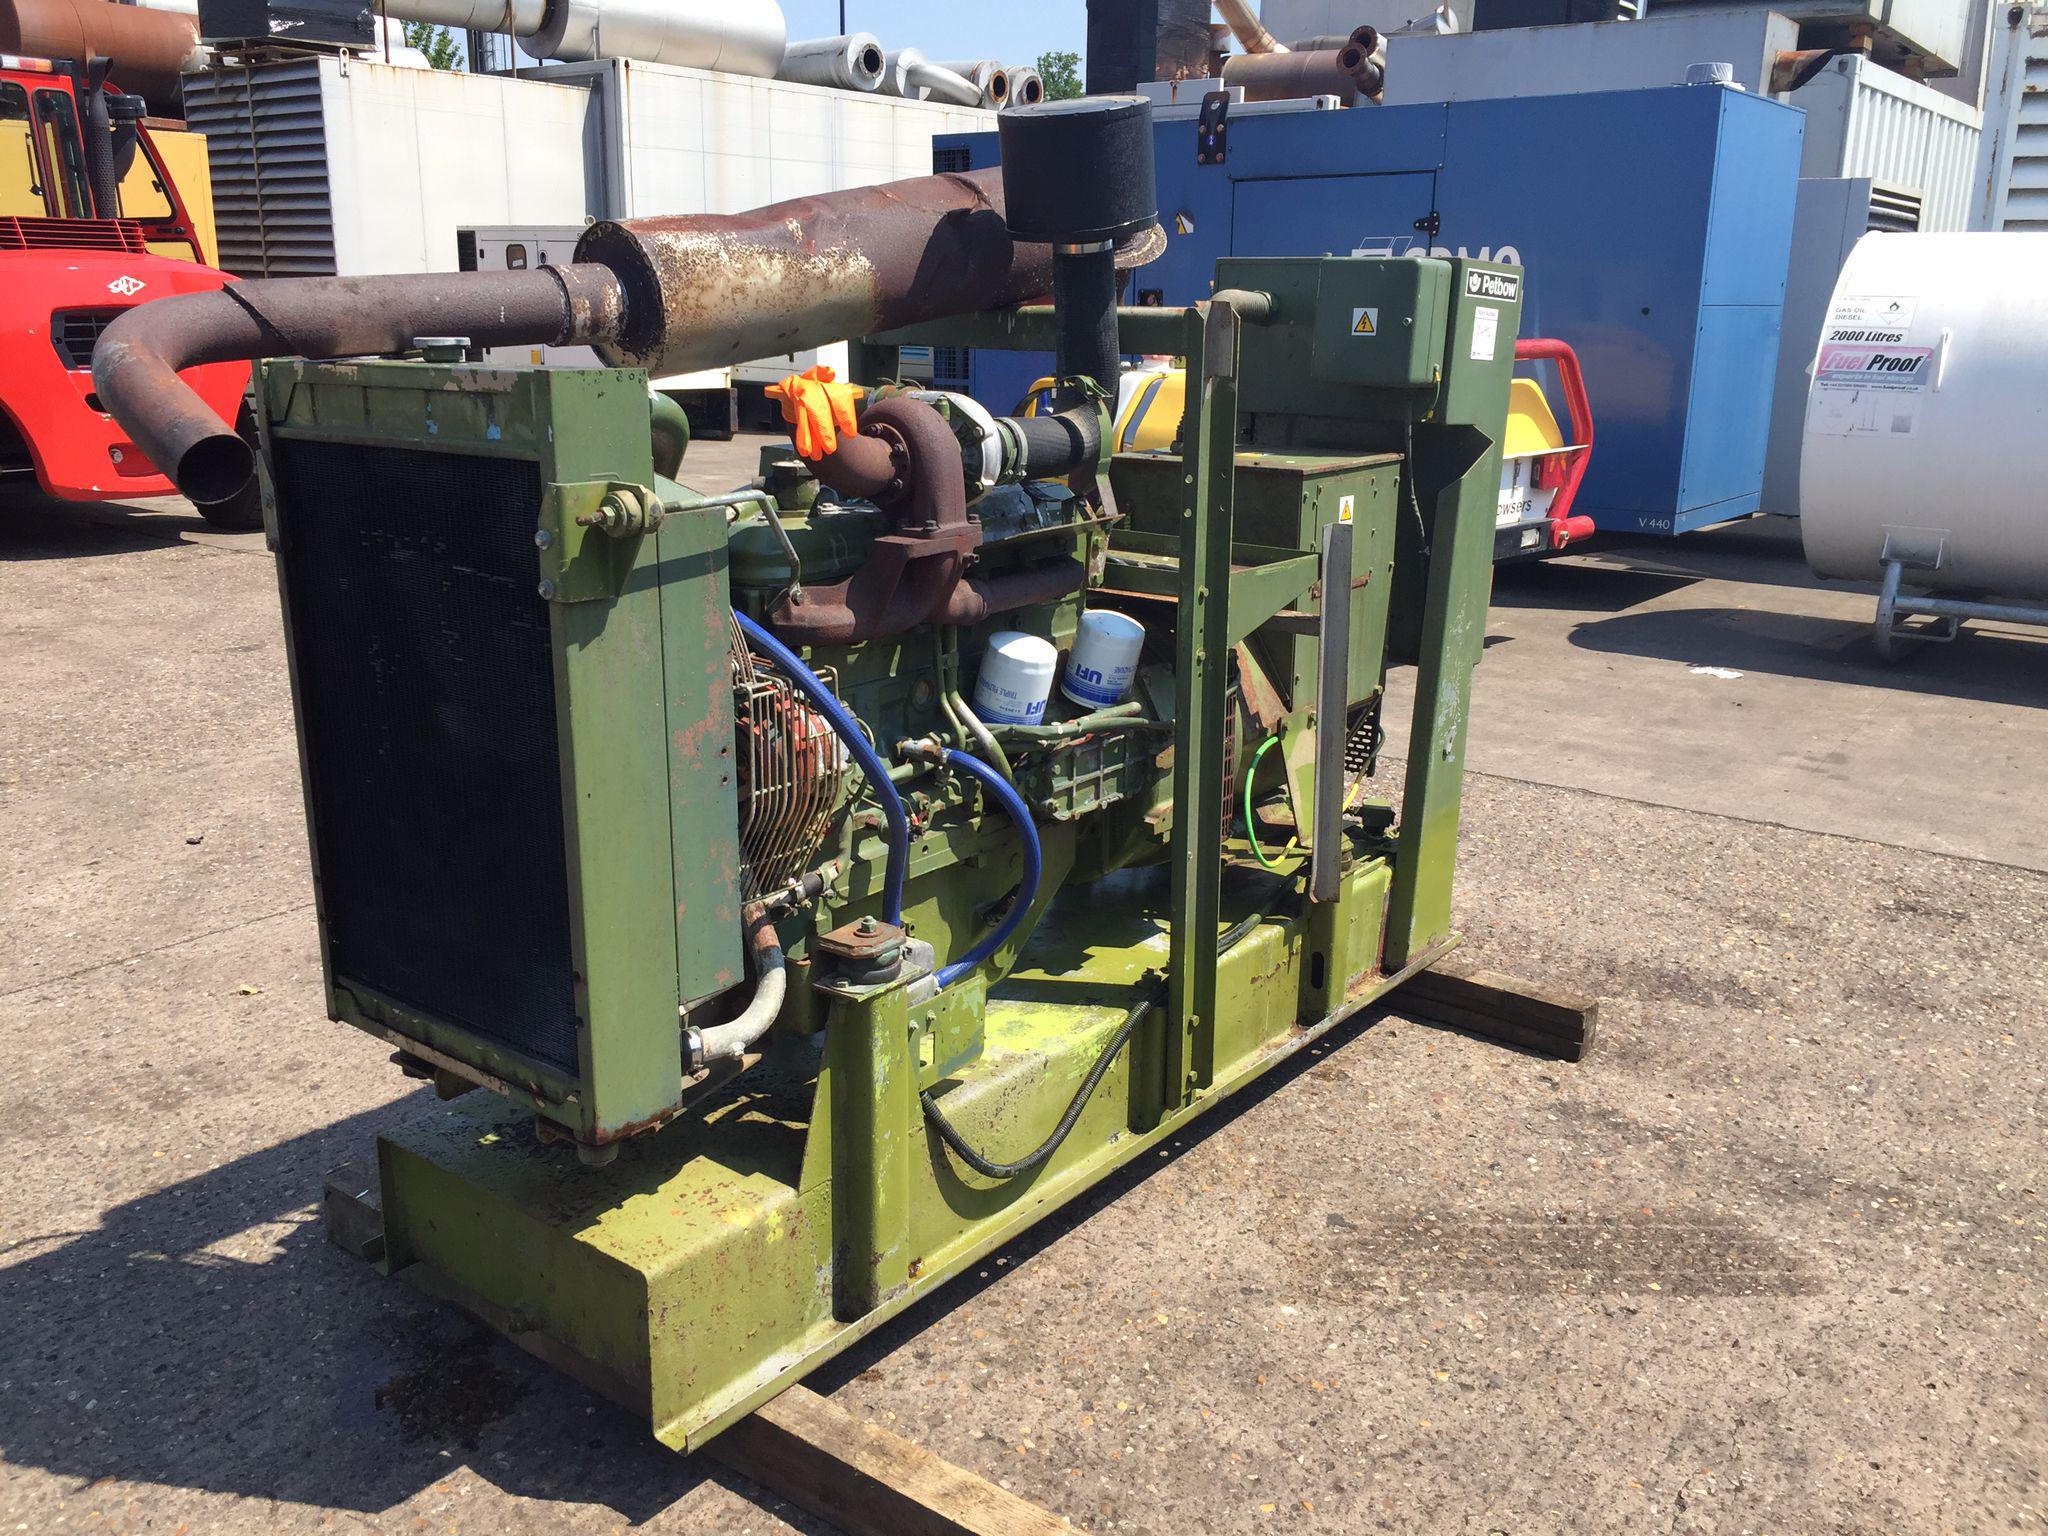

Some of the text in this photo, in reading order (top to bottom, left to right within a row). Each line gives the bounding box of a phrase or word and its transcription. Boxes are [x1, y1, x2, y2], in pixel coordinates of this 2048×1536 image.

[1482, 276, 1517, 298] Petbow
[1830, 331, 1903, 342] 2000 Litres
[1825, 352, 1923, 372] Fuel Proof
[1639, 518, 1670, 530] V 440
[1076, 664, 1102, 685] UFI
